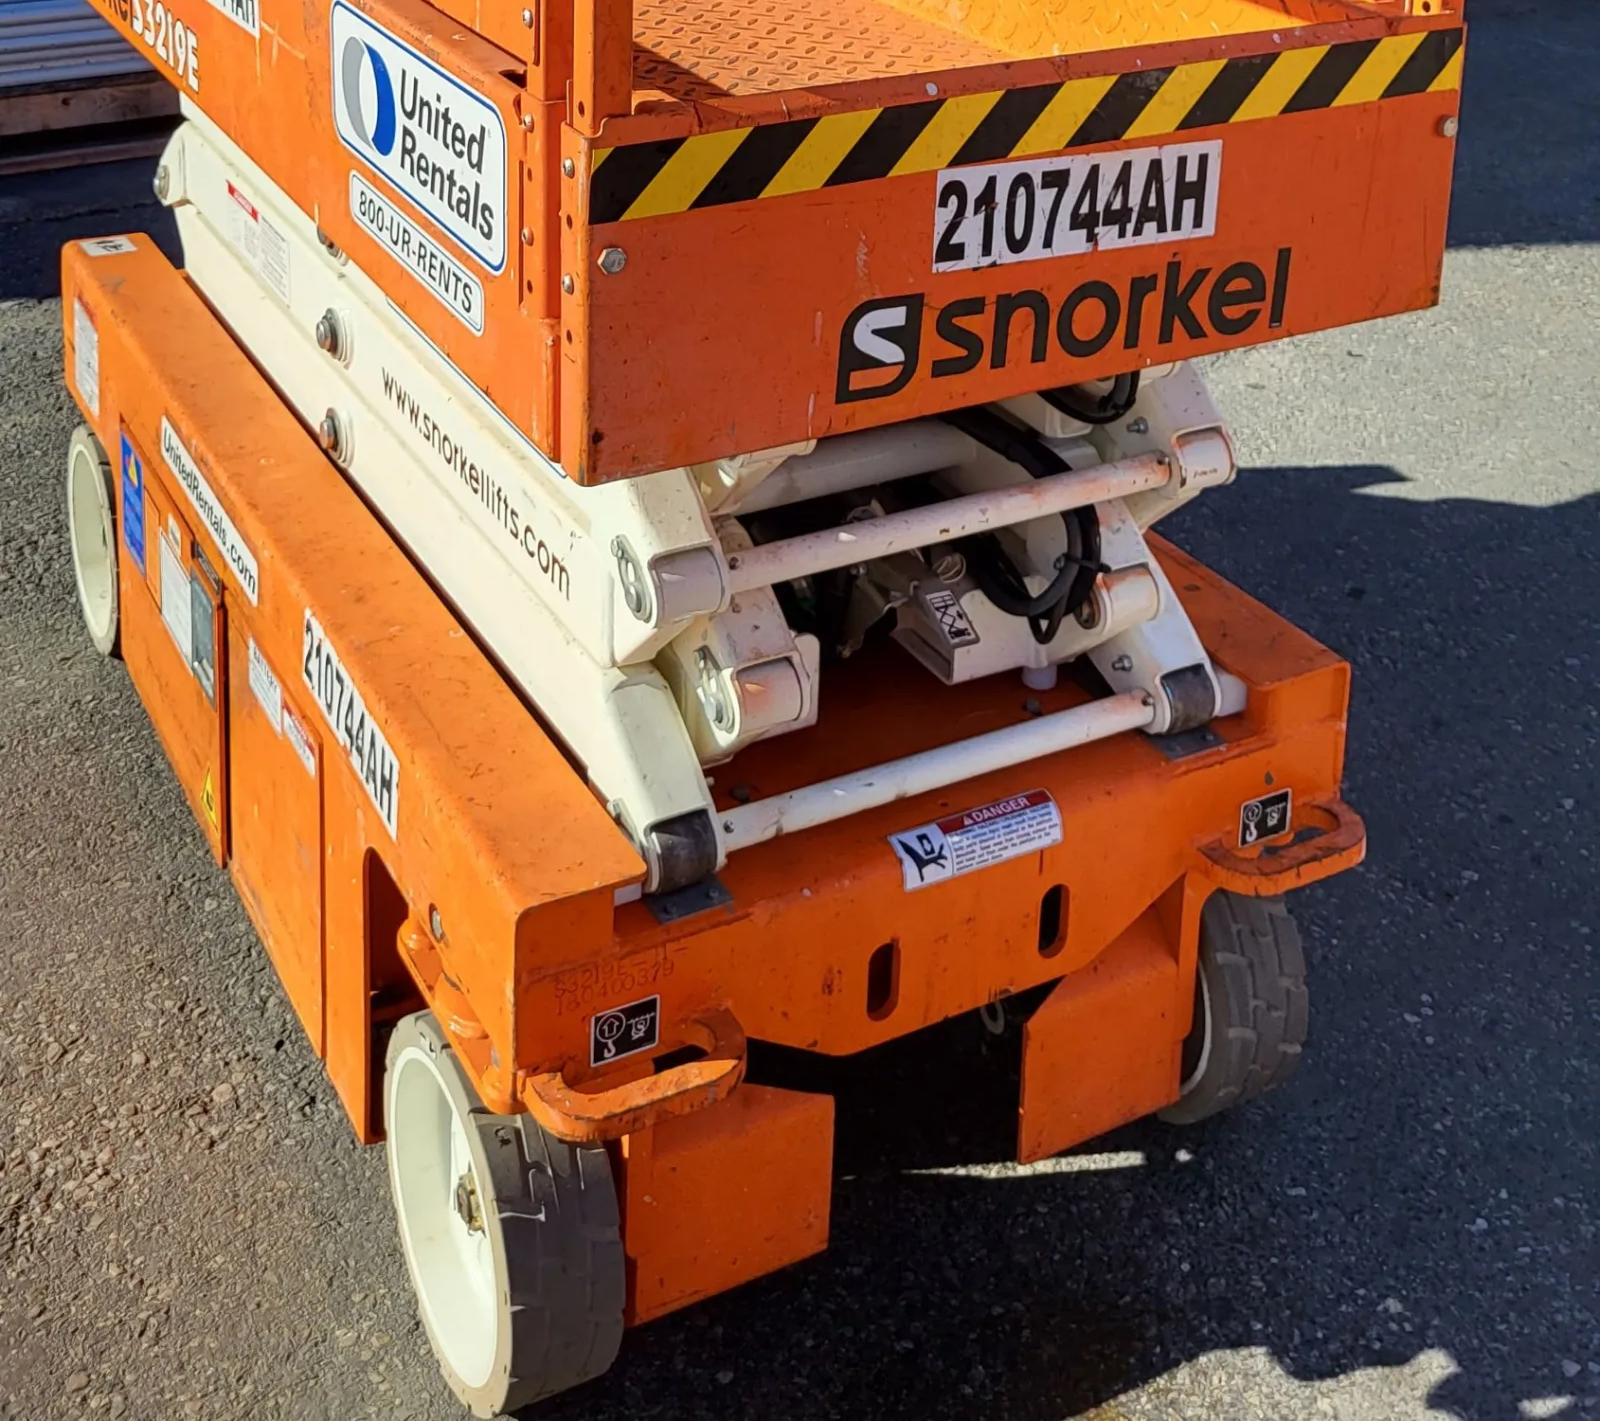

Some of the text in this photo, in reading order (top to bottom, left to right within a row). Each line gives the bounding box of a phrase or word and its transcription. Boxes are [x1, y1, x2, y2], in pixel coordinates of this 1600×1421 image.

[400, 67, 486, 175] United
[400, 124, 494, 241] Rentals
[358, 190, 474, 314] 800-UR-RENTS
[933, 152, 1210, 264] 210744AH
[930, 247, 1292, 379] snorkel
[163, 426, 257, 596] UnitedRentals.com
[381, 366, 570, 601] www.snorkellifts.com
[304, 617, 396, 823] 210744AH
[971, 796, 1031, 823] DANGER
